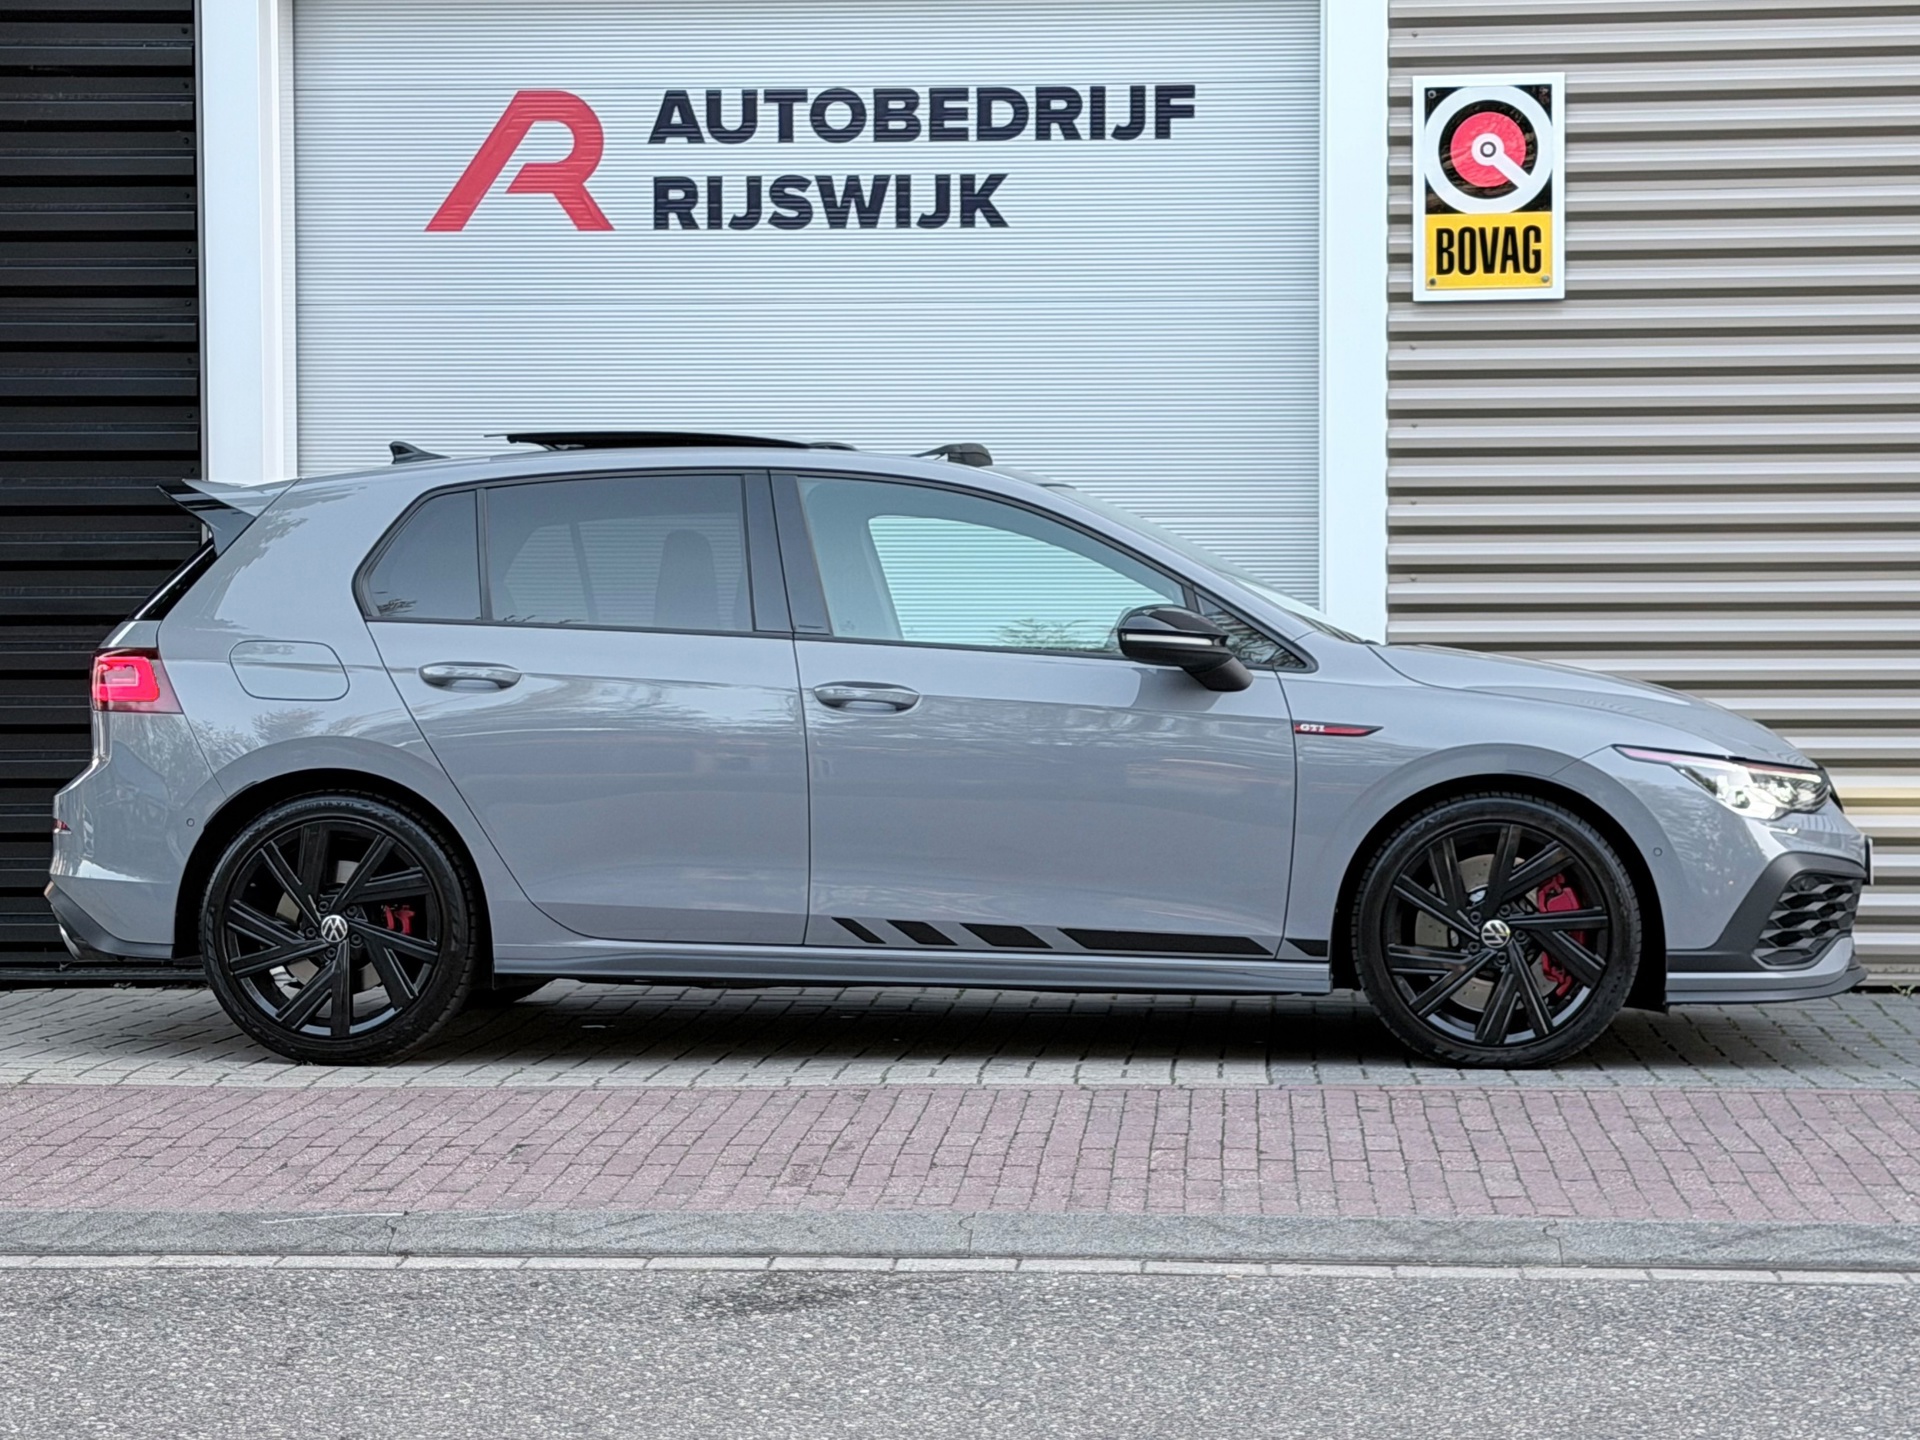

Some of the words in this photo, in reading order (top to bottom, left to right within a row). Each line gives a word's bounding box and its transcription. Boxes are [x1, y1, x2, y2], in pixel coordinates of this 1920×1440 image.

[648, 84, 1196, 144] AUTOBEDRIJF
[653, 173, 1009, 231] RIJSWIJK
[1436, 225, 1542, 275] BOVAG
[1300, 723, 1326, 733] GTI
